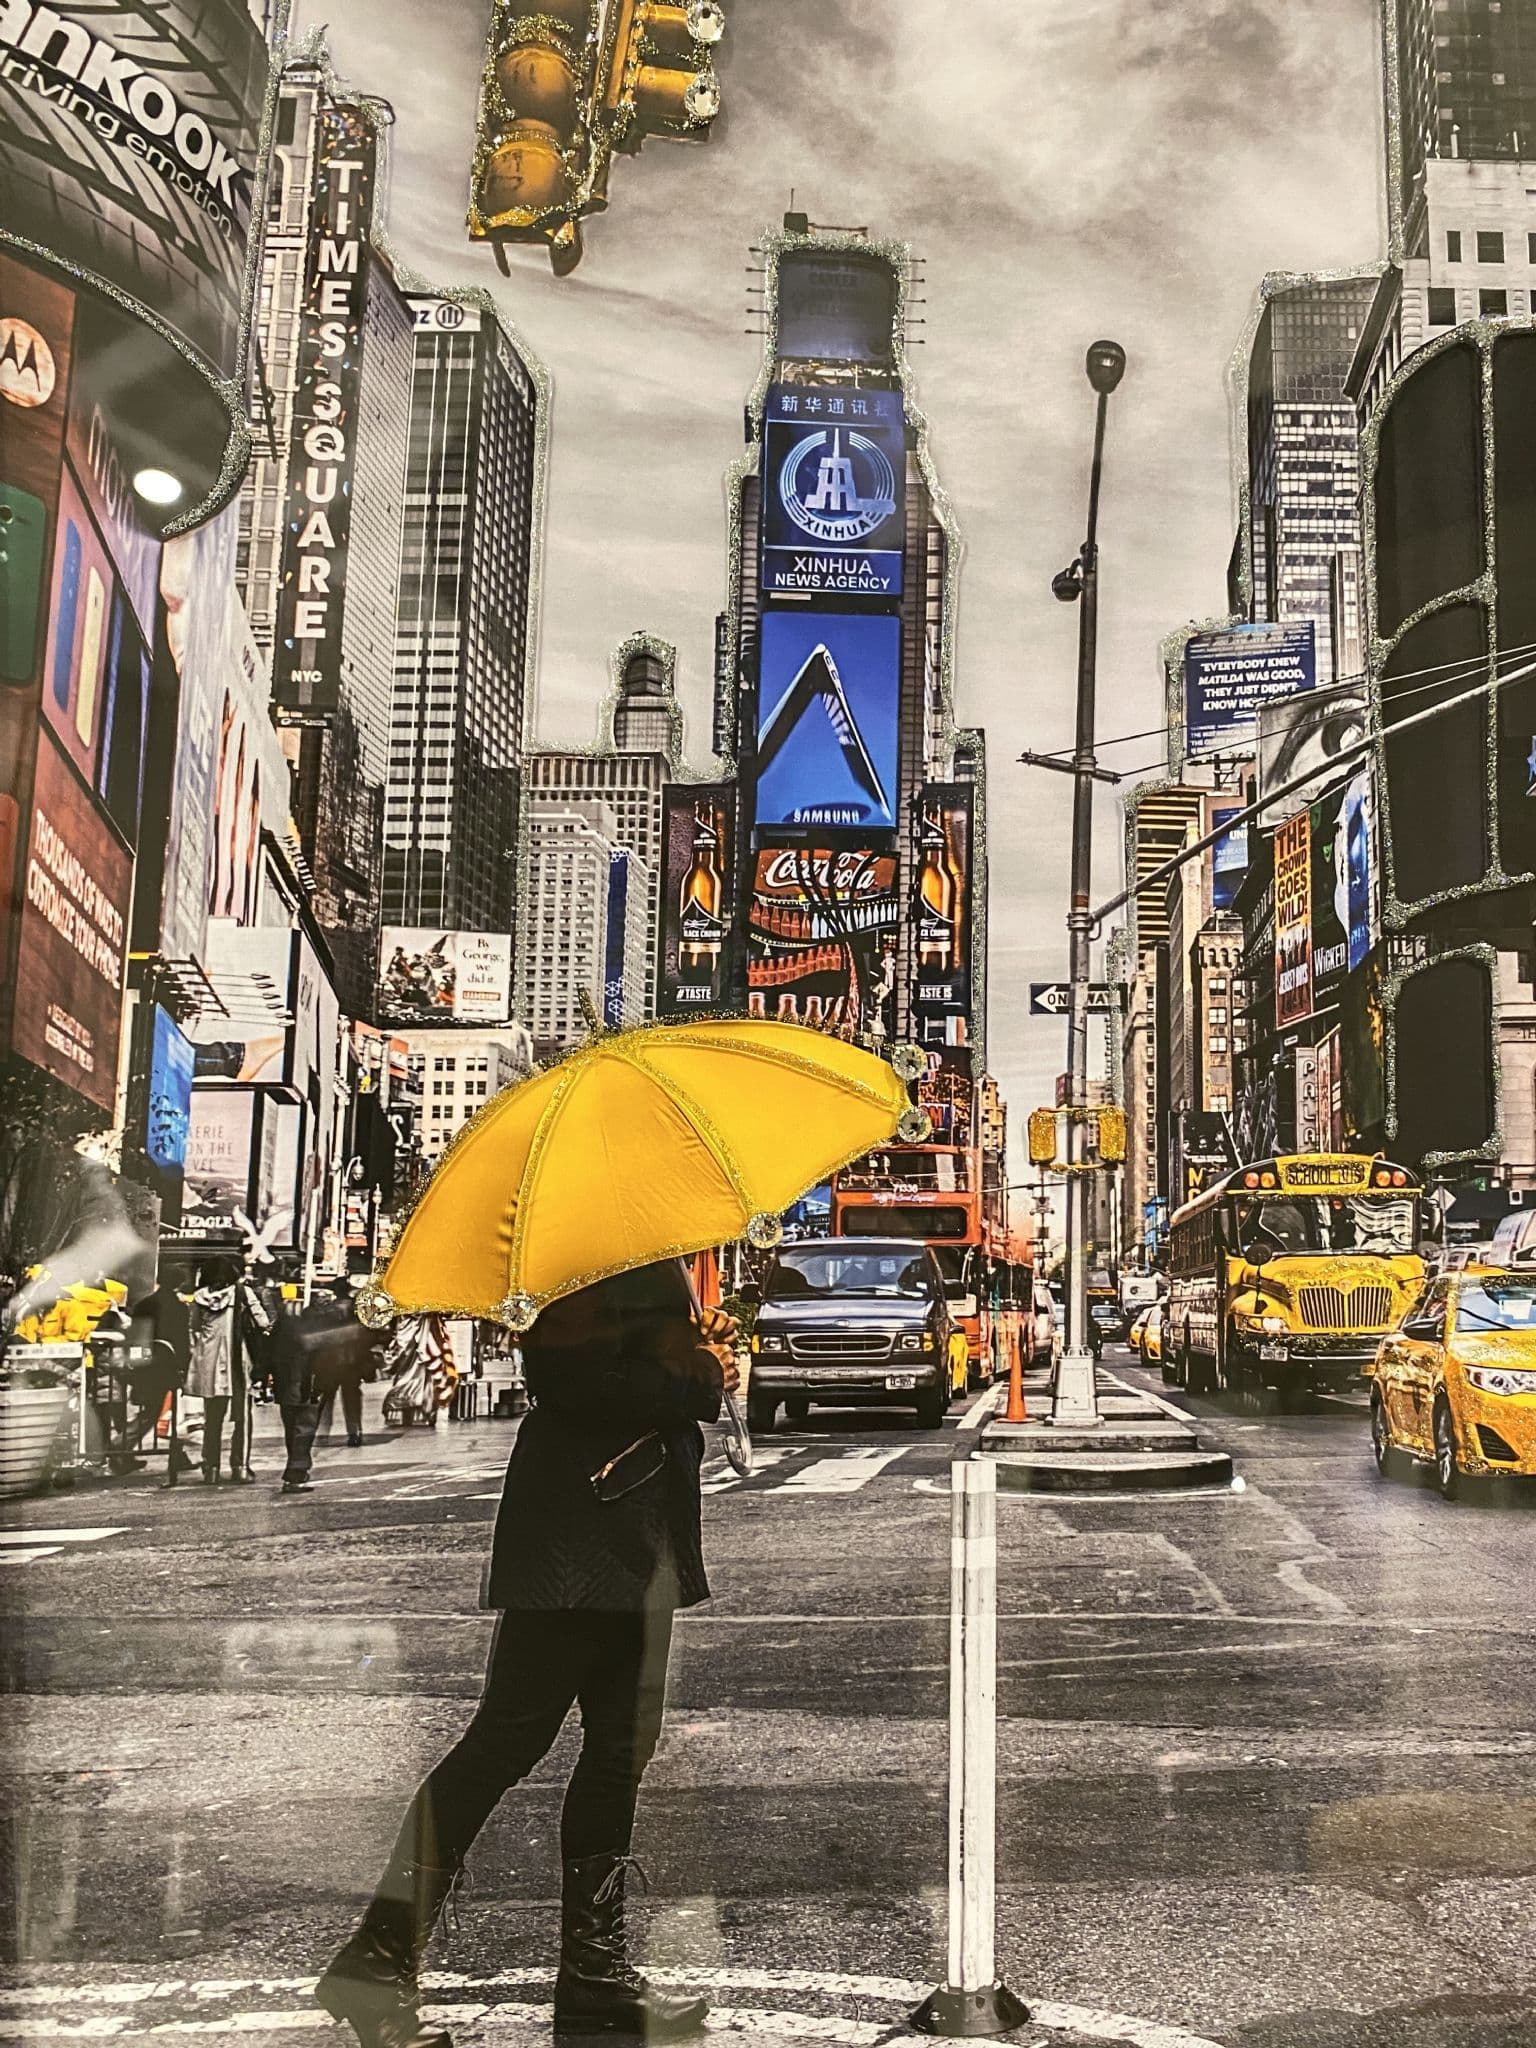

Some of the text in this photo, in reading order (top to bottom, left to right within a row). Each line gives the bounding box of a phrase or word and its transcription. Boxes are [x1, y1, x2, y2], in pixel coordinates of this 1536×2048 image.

[0, 50, 234, 238] riving emotion
[318, 160, 364, 357] TIMES
[294, 382, 346, 640] SQUARE
[803, 516, 871, 539] XINHUA
[793, 556, 873, 575] XINHUA
[775, 573, 890, 590] NEWS AGENCY
[1267, 656, 1301, 667] KNEW
[291, 669, 323, 683] NYC
[1198, 674, 1244, 685] MATILDA
[1246, 671, 1270, 682] WAS
[1204, 686, 1233, 698] THEY
[1233, 684, 1260, 696] JUST
[1202, 699, 1238, 711] KNOW
[1276, 814, 1307, 859] THE
[1277, 848, 1307, 879] CROWD
[1277, 866, 1308, 903] GOES
[1277, 891, 1309, 928] WILD!
[676, 988, 711, 1000] #TASTE
[1302, 1059, 1316, 1150] PALA
[210, 1142, 233, 1156] THE
[189, 1215, 233, 1228] EAGLE
